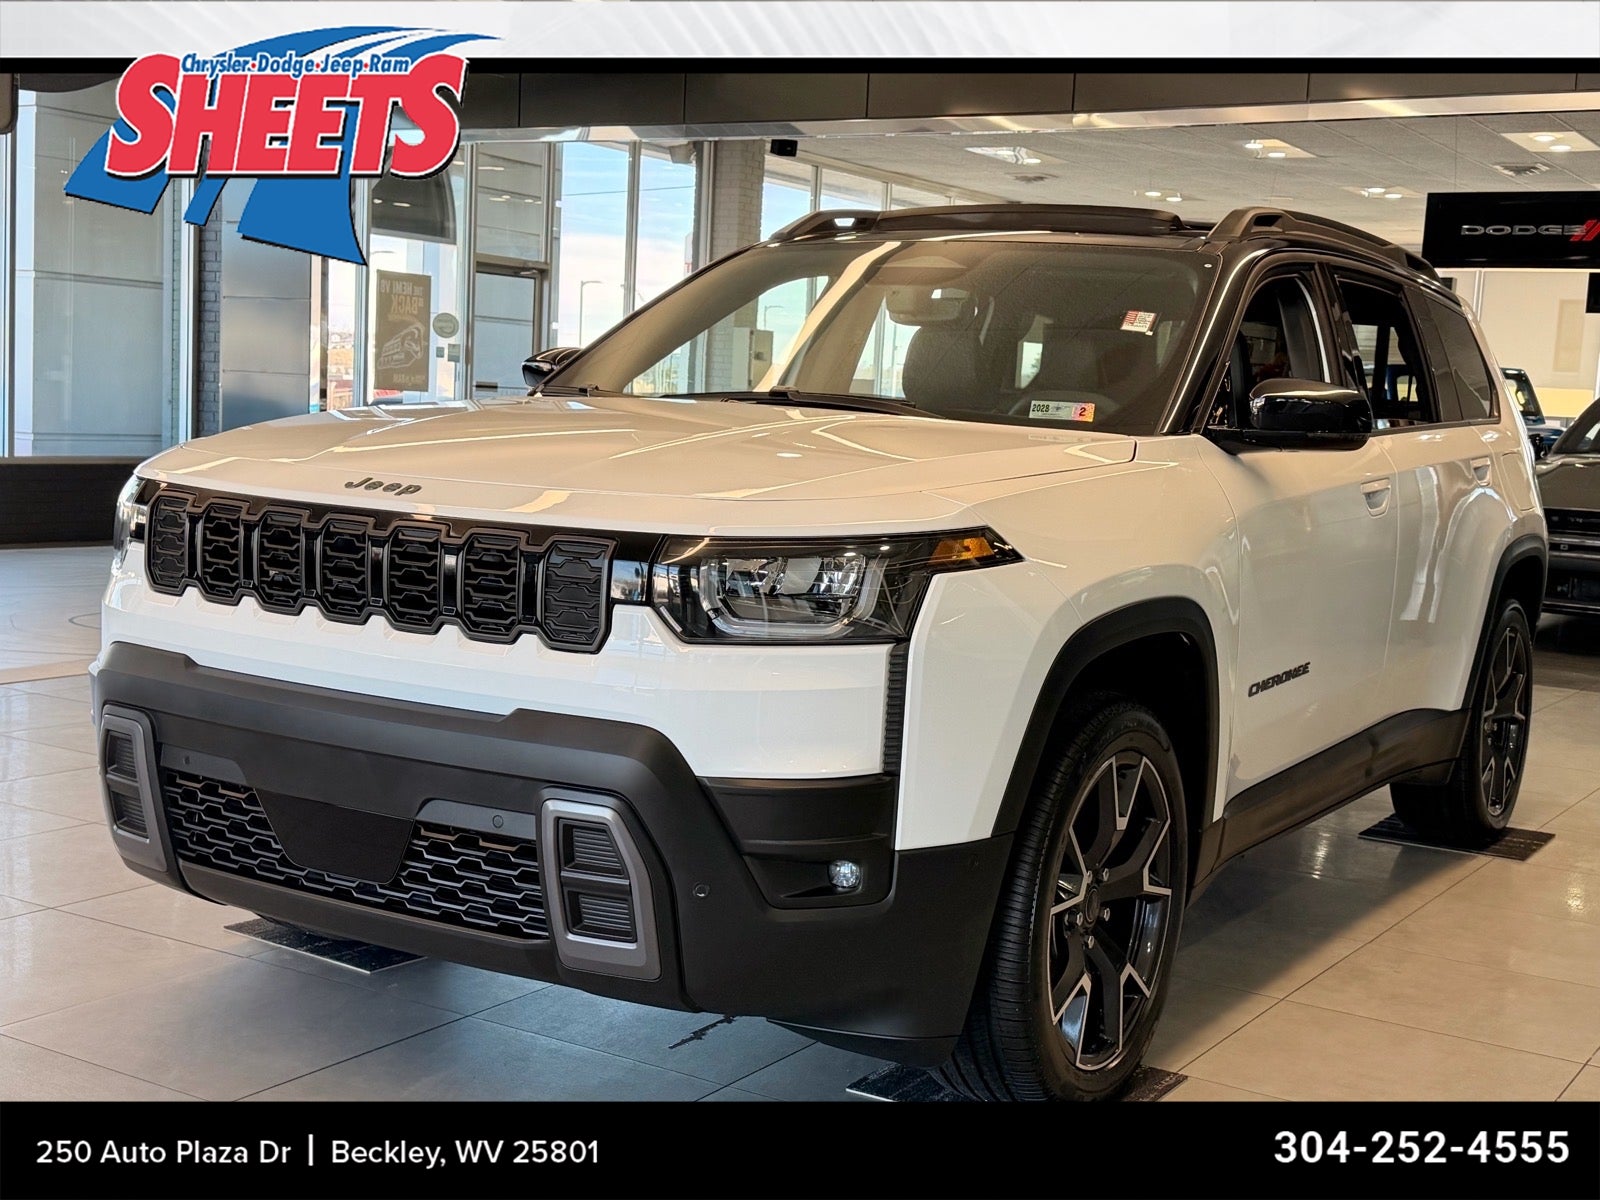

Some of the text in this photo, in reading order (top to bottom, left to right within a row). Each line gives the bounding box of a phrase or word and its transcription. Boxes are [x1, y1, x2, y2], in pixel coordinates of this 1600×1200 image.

[1460, 225, 1587, 235] DODGE
[1032, 404, 1087, 416] 2028 2
[344, 477, 422, 496] Jeep
[1248, 661, 1311, 697] CHEROKEE
